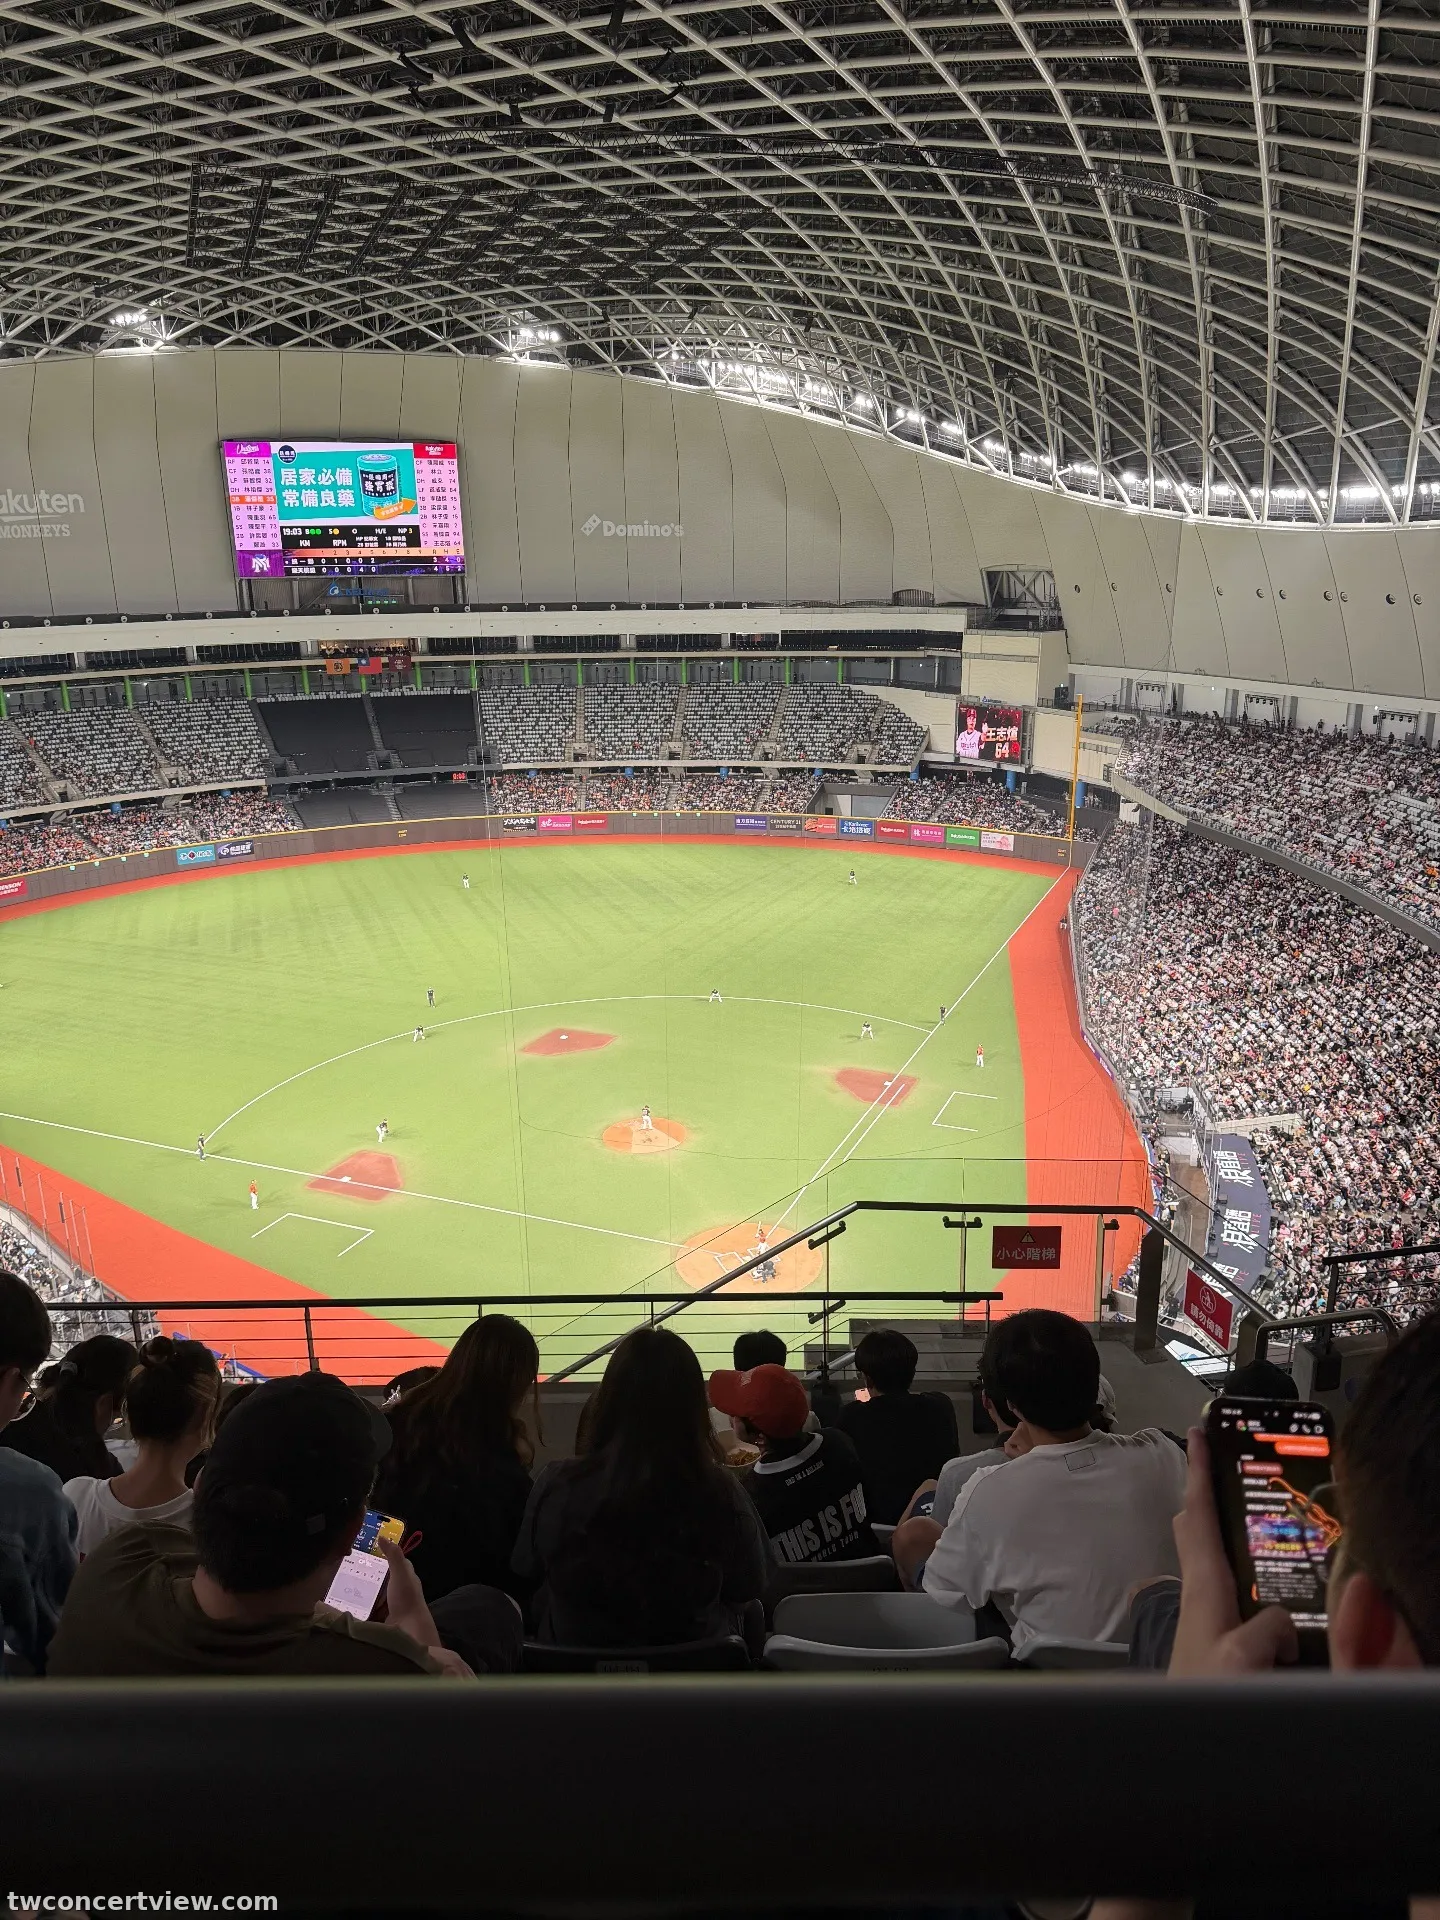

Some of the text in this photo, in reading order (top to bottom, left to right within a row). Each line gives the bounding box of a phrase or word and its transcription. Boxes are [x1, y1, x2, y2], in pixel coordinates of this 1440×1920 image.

[280, 468, 353, 486] 居家必備
[282, 489, 356, 508] 常備良藥
[0, 524, 71, 538] MONKEYS
[602, 520, 684, 537] Domino's
[996, 742, 1010, 758] 64
[1237, 1152, 1250, 1170] LIVE
[1252, 1213, 1262, 1234] LIVE
[996, 1246, 1056, 1260] 小心階梯
[1190, 1302, 1224, 1340] 請勿倚靠
[770, 1518, 822, 1562] THIS
[818, 1504, 842, 1544] IS
[811, 1531, 860, 1562] WORLD TOUR
